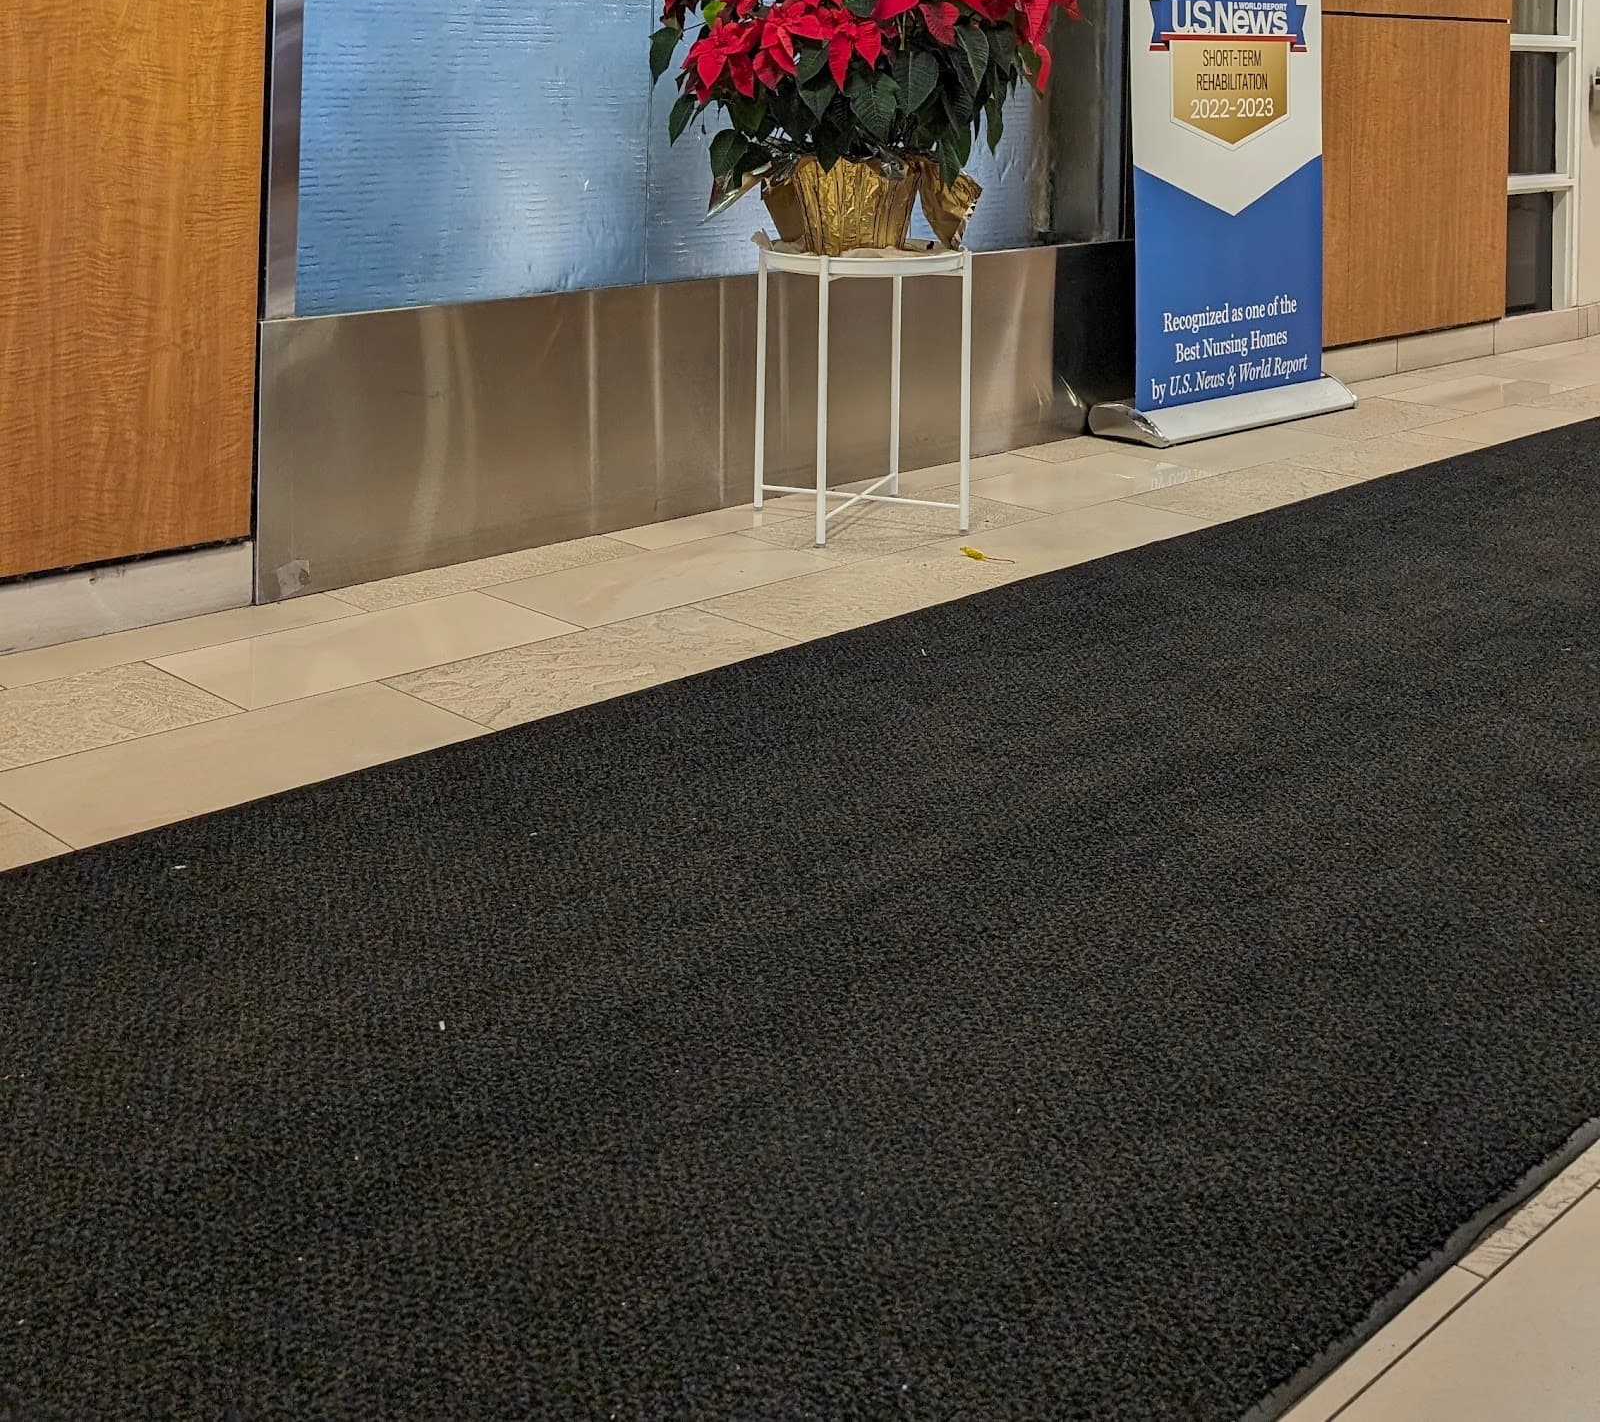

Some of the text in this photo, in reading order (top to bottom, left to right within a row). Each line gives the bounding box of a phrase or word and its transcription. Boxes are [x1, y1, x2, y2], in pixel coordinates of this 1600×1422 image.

[1239, 2, 1262, 10] WORLD
[1262, 3, 1287, 11] REPORT
[1203, 49, 1262, 67] SHORT-TERM
[1196, 73, 1268, 91] REHABILITATION
[1190, 98, 1274, 119] 2022-2023
[1163, 294, 1297, 334] Recognized as one of the
[1175, 330, 1288, 363] Best Nursing Homes
[1151, 354, 1308, 404] by U.S. News & World Report
